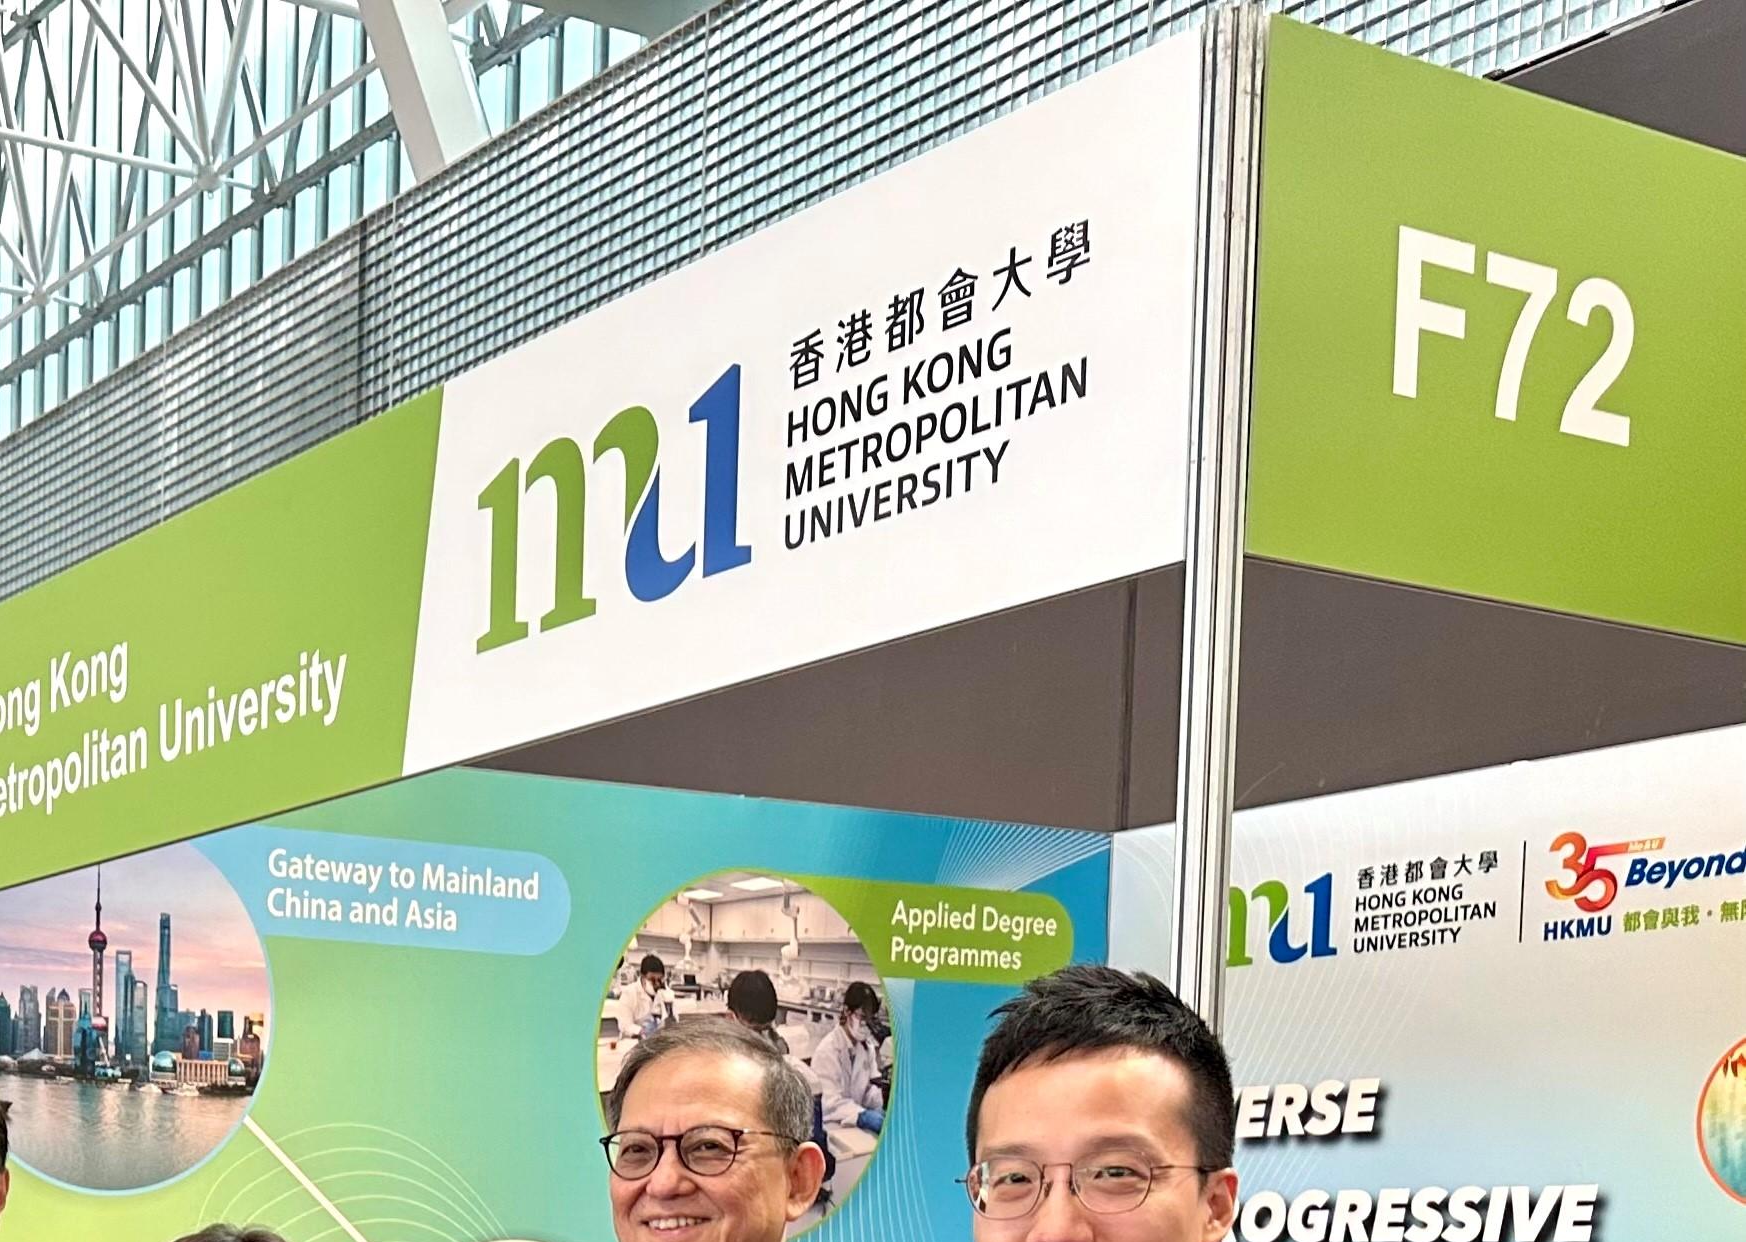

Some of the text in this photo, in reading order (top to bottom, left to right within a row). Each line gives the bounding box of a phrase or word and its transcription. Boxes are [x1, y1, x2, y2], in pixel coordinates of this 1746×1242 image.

[788, 219, 1092, 391] 香港都會大學
[1392, 224, 1635, 448] F72
[786, 326, 1013, 448] HONG KONG
[785, 356, 1088, 499] METROPOLITAN
[784, 441, 1011, 550] UNIVERSITY
[50, 641, 129, 713] Kong
[159, 648, 348, 762] University
[268, 848, 541, 901] Gateway to Mainland
[1357, 849, 1499, 890] 香港都會大學
[1545, 831, 1618, 913] 35
[1624, 847, 1746, 889] Beyond
[267, 886, 459, 932] China and Asia
[891, 899, 1058, 941] Applied Degree
[1354, 902, 1496, 933] METROPOLITAN
[1355, 883, 1464, 912] HONG KONG
[1353, 927, 1462, 954] UNIVERSITY
[1543, 914, 1613, 941] HKMU
[889, 936, 1023, 974] Programmes
[1233, 1078, 1381, 1139] ERSE
